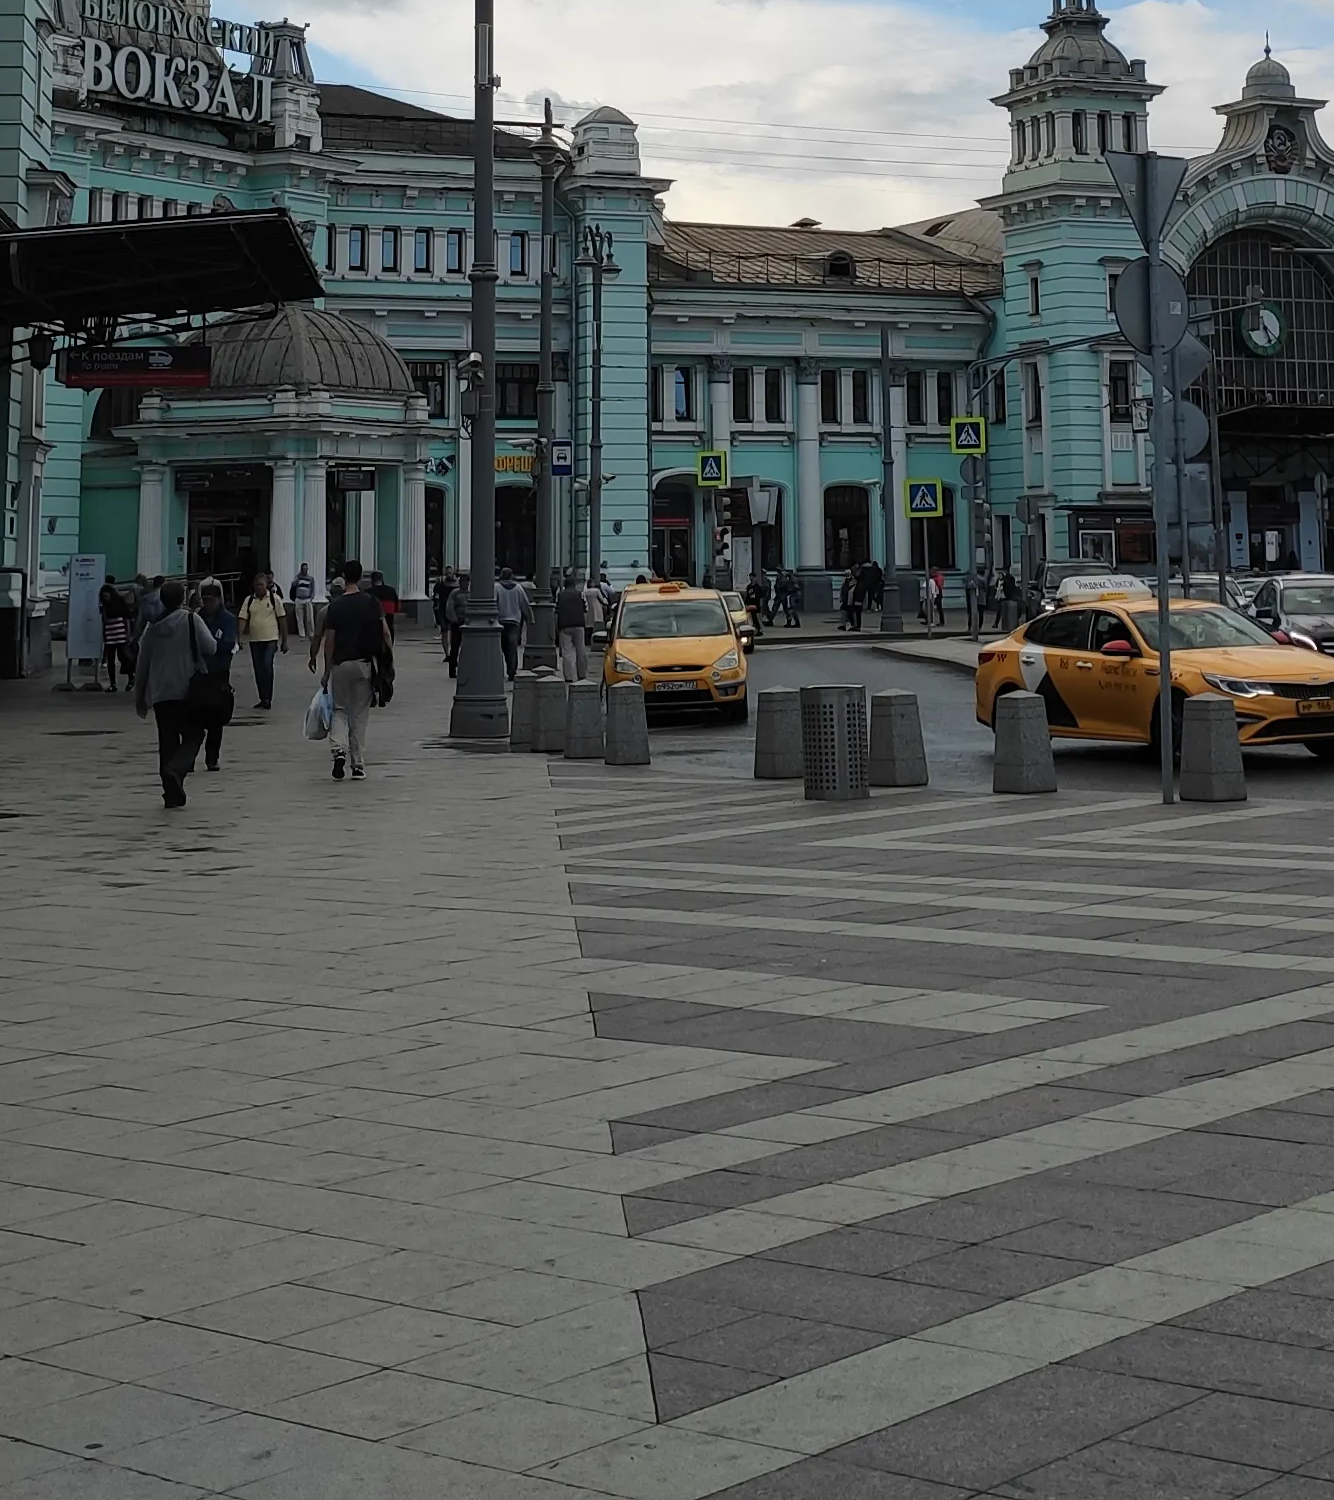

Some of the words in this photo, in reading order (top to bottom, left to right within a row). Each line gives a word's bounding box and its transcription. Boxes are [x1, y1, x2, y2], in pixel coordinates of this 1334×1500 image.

[81, 36, 276, 124] ВОКЗАЛ
[81, 351, 91, 361] К
[92, 352, 145, 363] поездам
[1075, 579, 1108, 591] Яндекс
[1107, 579, 1136, 590] Такси
